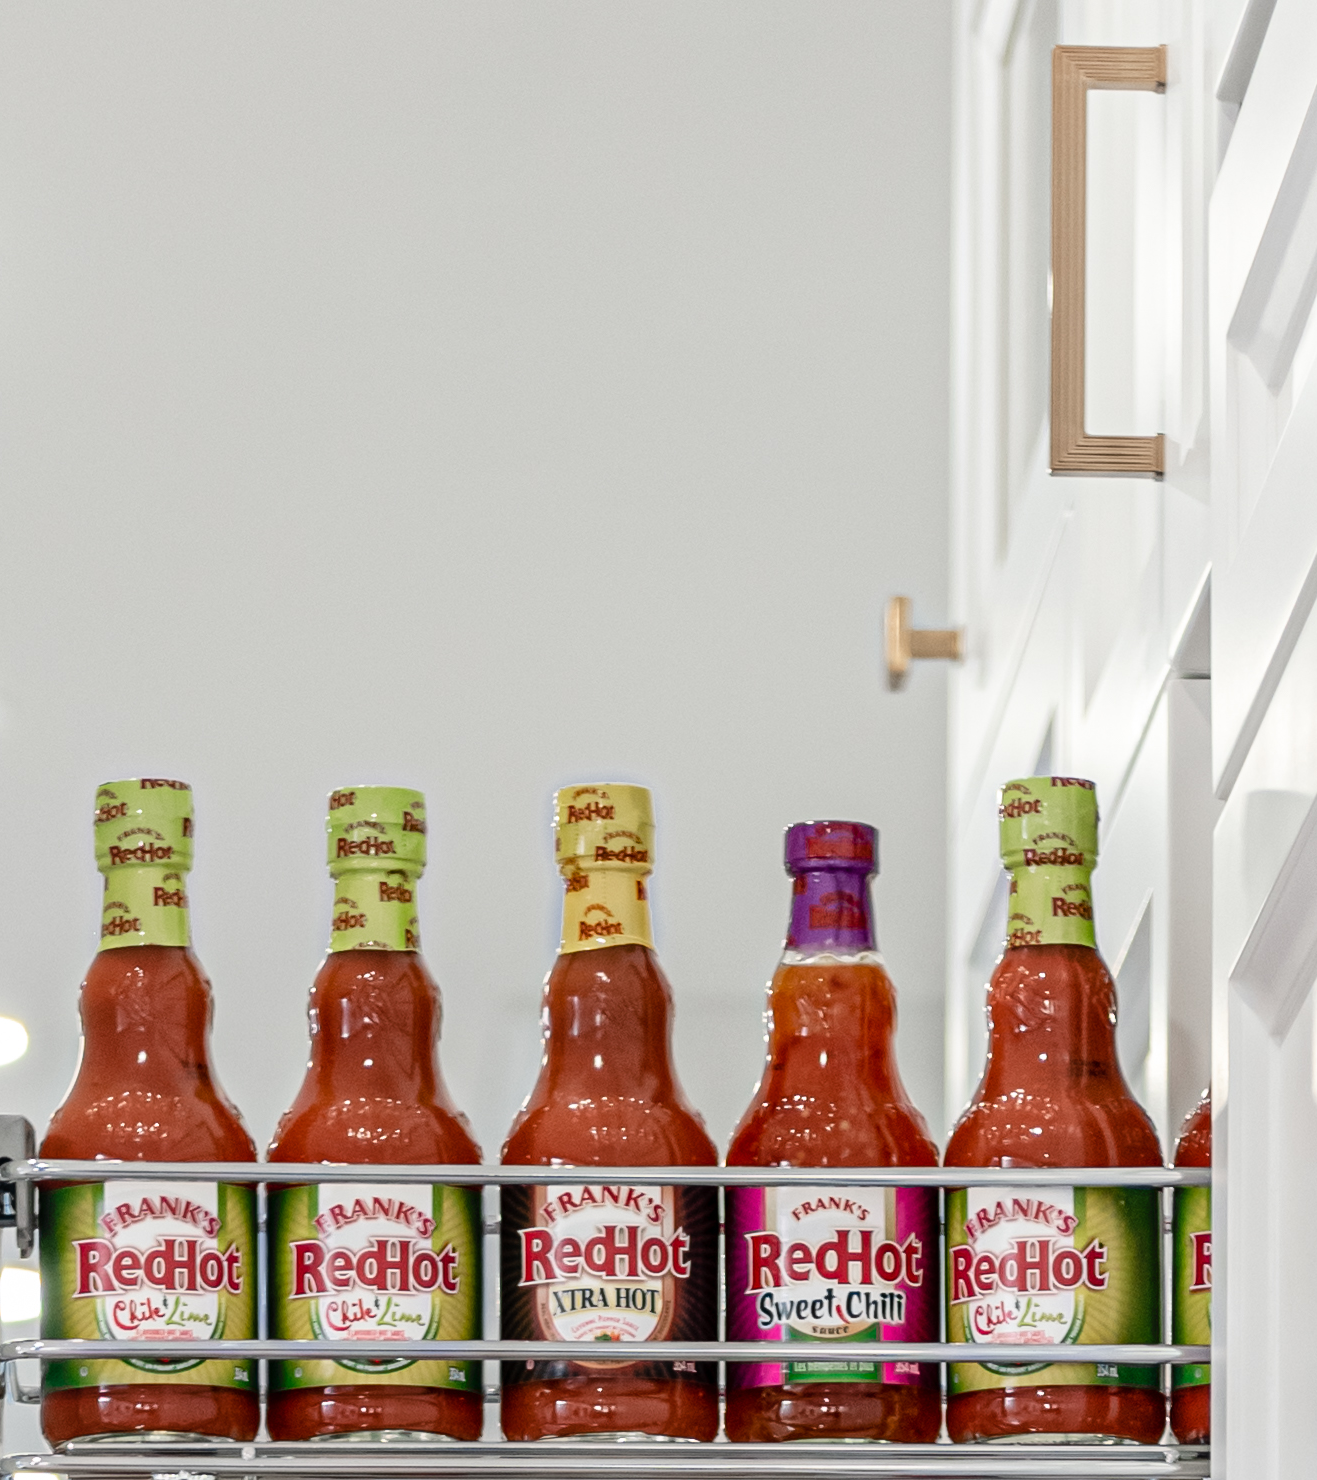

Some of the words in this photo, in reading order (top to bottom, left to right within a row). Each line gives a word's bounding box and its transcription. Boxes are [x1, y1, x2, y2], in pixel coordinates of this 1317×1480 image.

[1023, 847, 1084, 867] RedHot
[99, 1196, 222, 1239] FRANK'S
[313, 1197, 436, 1239] FRANK'S
[542, 1186, 666, 1225] FRANK'S
[791, 1196, 870, 1222] FRANK'S
[964, 1198, 1079, 1240] FRANK'S
[72, 1235, 243, 1298] RedHot
[288, 1236, 460, 1299] RedHot
[518, 1225, 691, 1287] RedHot
[744, 1227, 923, 1295] RedHot
[950, 1238, 1110, 1306] RedHot
[113, 1297, 166, 1331] Chile
[165, 1296, 212, 1326] Lime
[326, 1297, 377, 1332] Chile
[376, 1296, 426, 1327] Lime
[552, 1287, 610, 1317] XTRA
[615, 1287, 660, 1314] HOT
[759, 1287, 837, 1327] Sweet
[845, 1291, 905, 1322] Chili
[975, 1300, 1019, 1335] Chile
[1017, 1297, 1068, 1328] Lime
[811, 1325, 850, 1335] sauce
